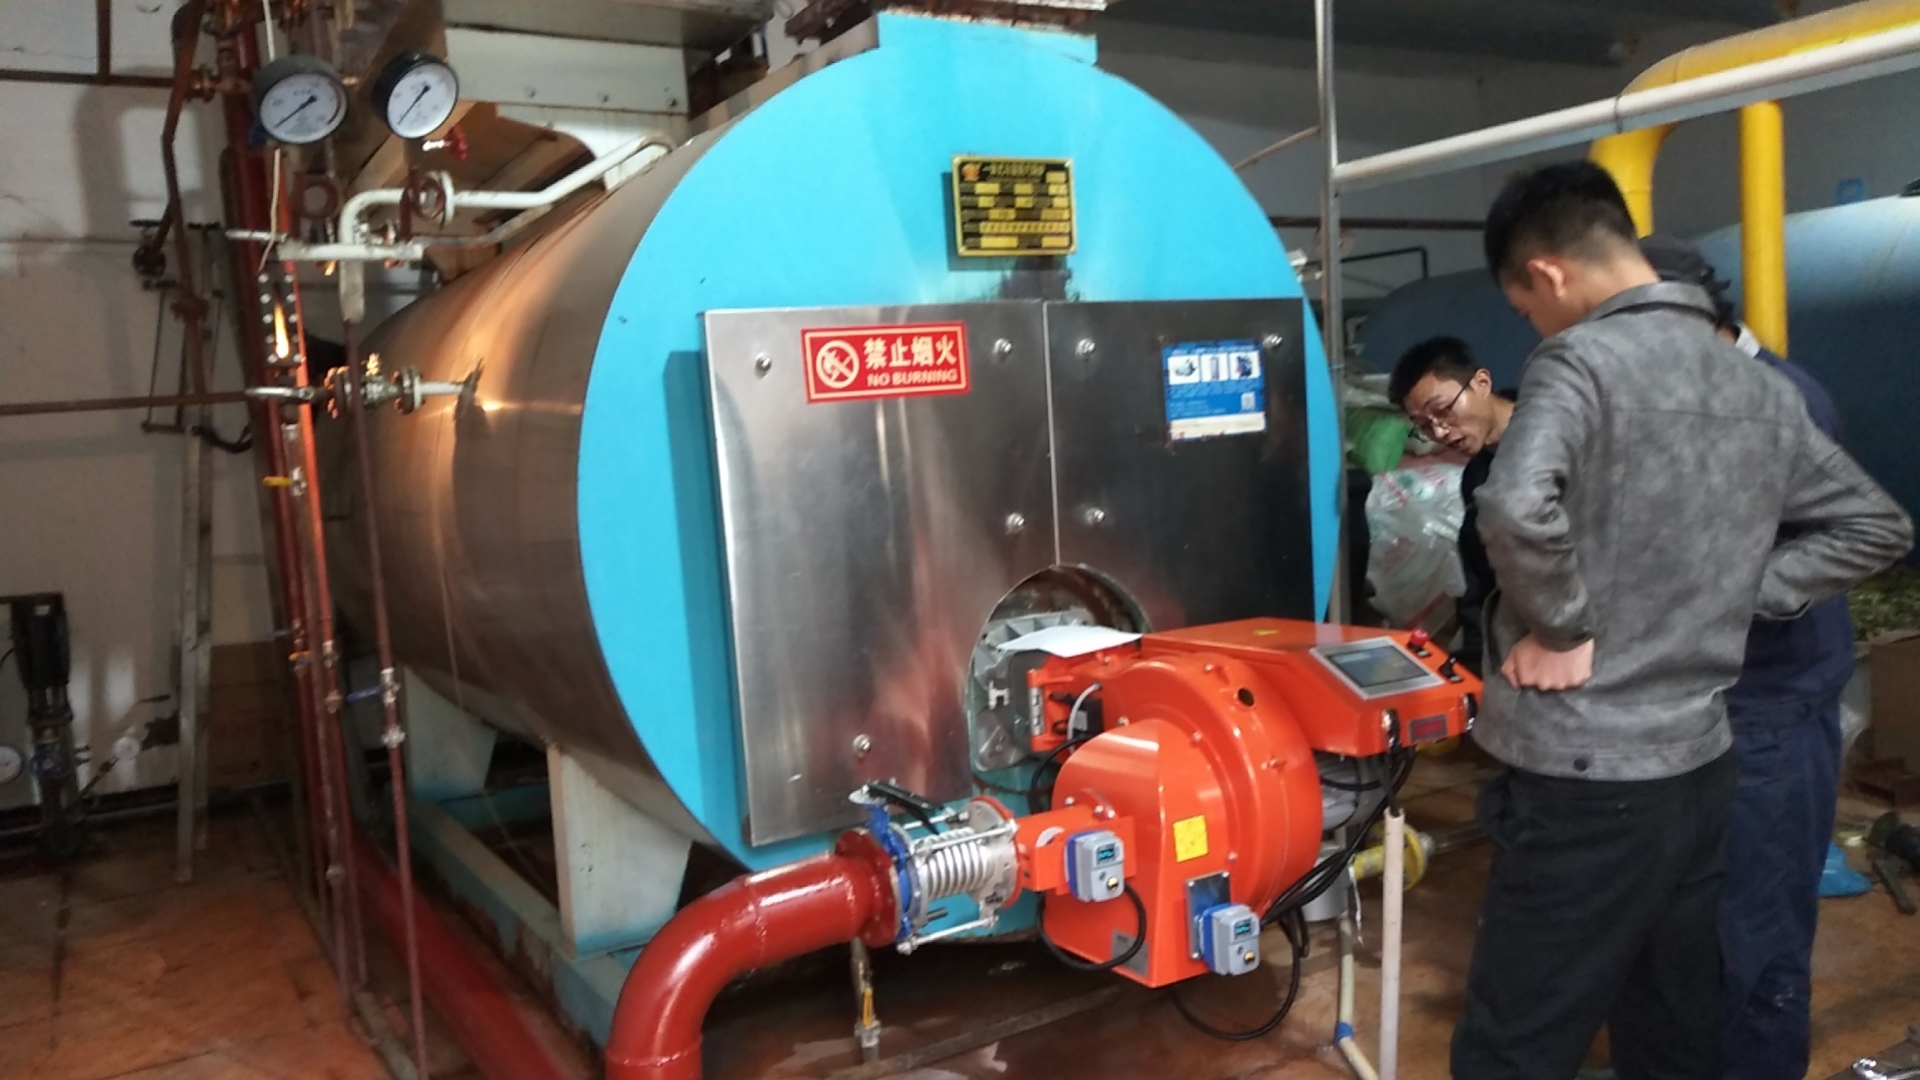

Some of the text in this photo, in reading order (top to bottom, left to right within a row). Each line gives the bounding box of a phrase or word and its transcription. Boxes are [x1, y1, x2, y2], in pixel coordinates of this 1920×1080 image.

[863, 335, 957, 370] 禁止烟火
[867, 368, 958, 387] NO BURNING
